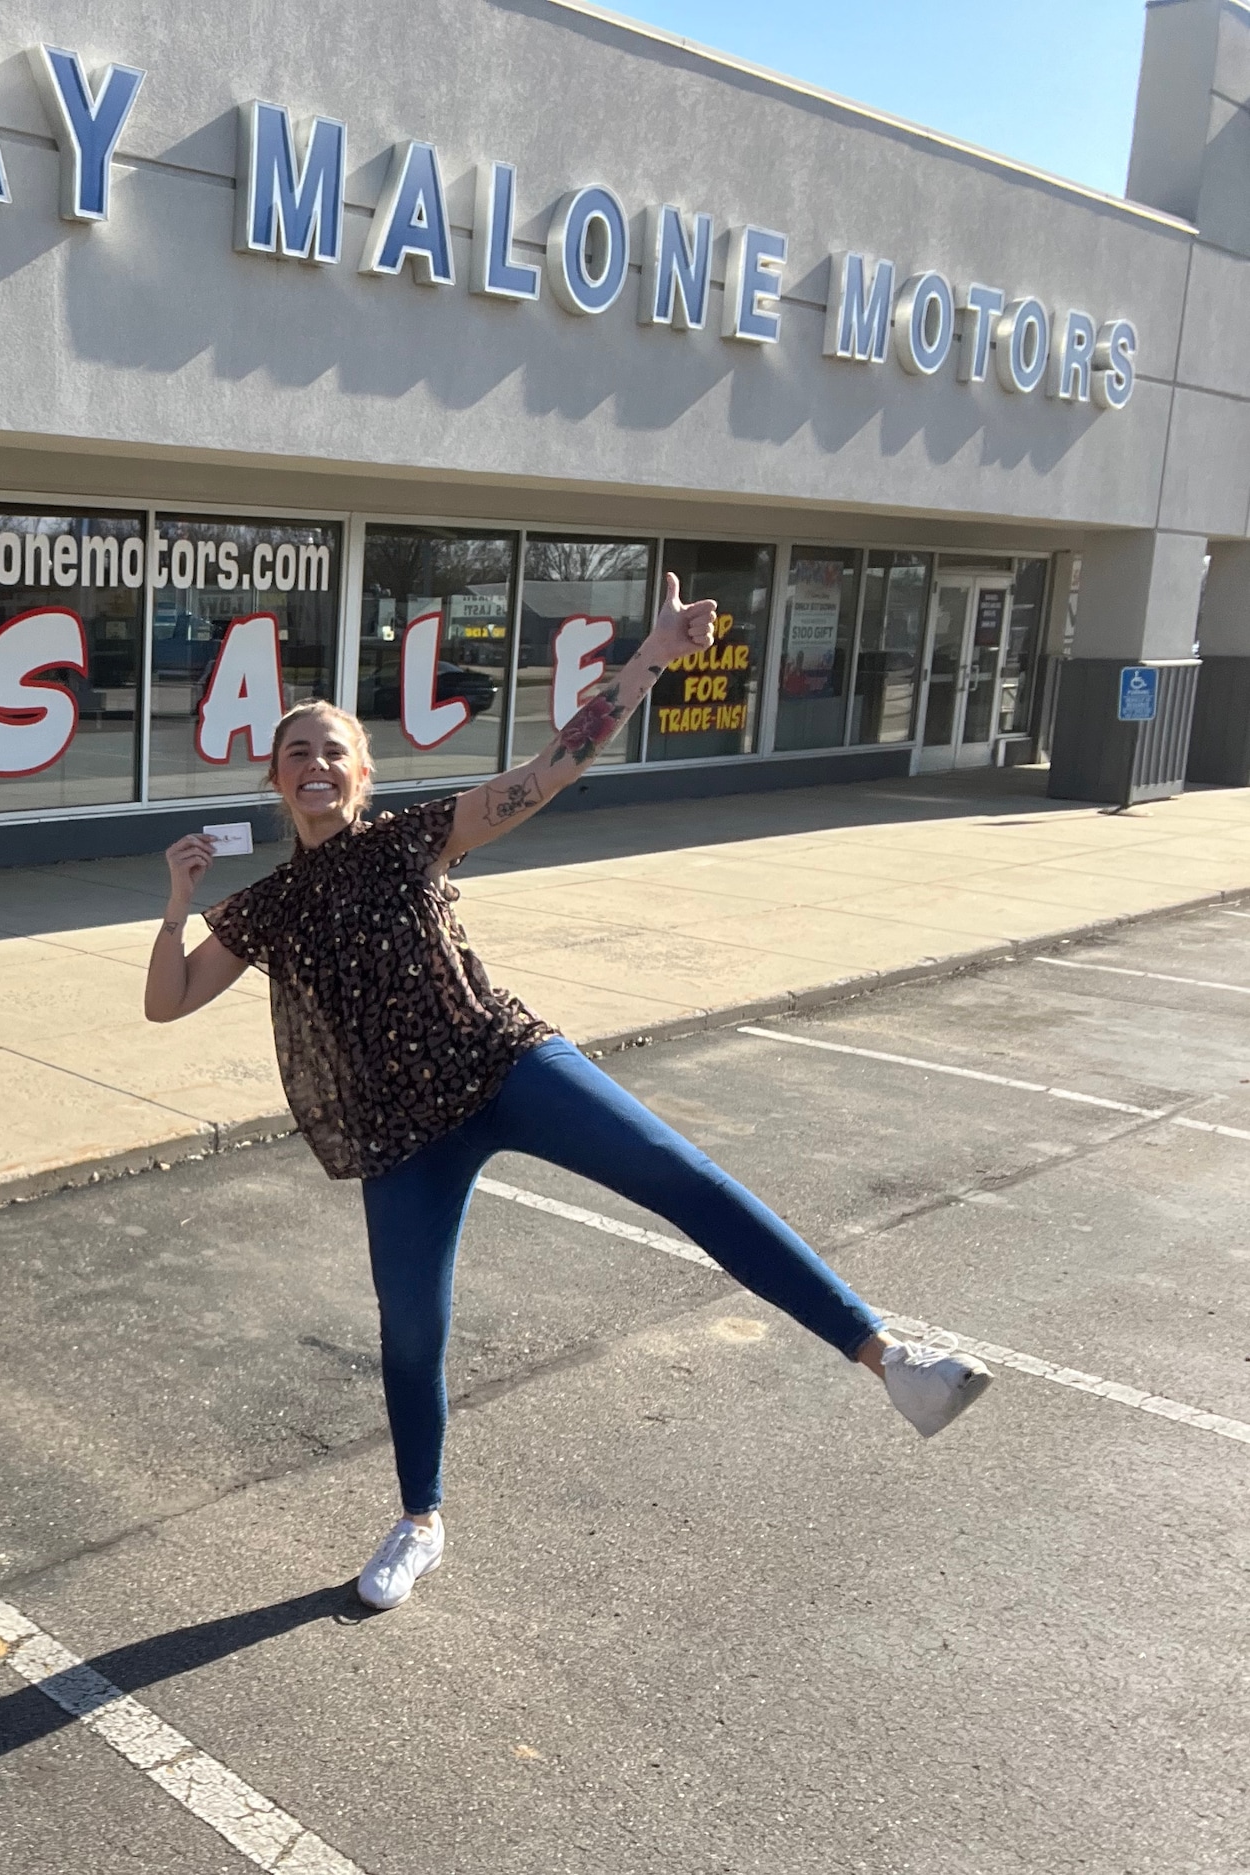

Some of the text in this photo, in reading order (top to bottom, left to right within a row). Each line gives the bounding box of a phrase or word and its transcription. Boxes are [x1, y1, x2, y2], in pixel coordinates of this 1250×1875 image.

[238, 98, 788, 344] MALONE
[826, 250, 1137, 410] MOTORS
[684, 675, 729, 703] FOR
[657, 704, 748, 735] TRADE-INS!
